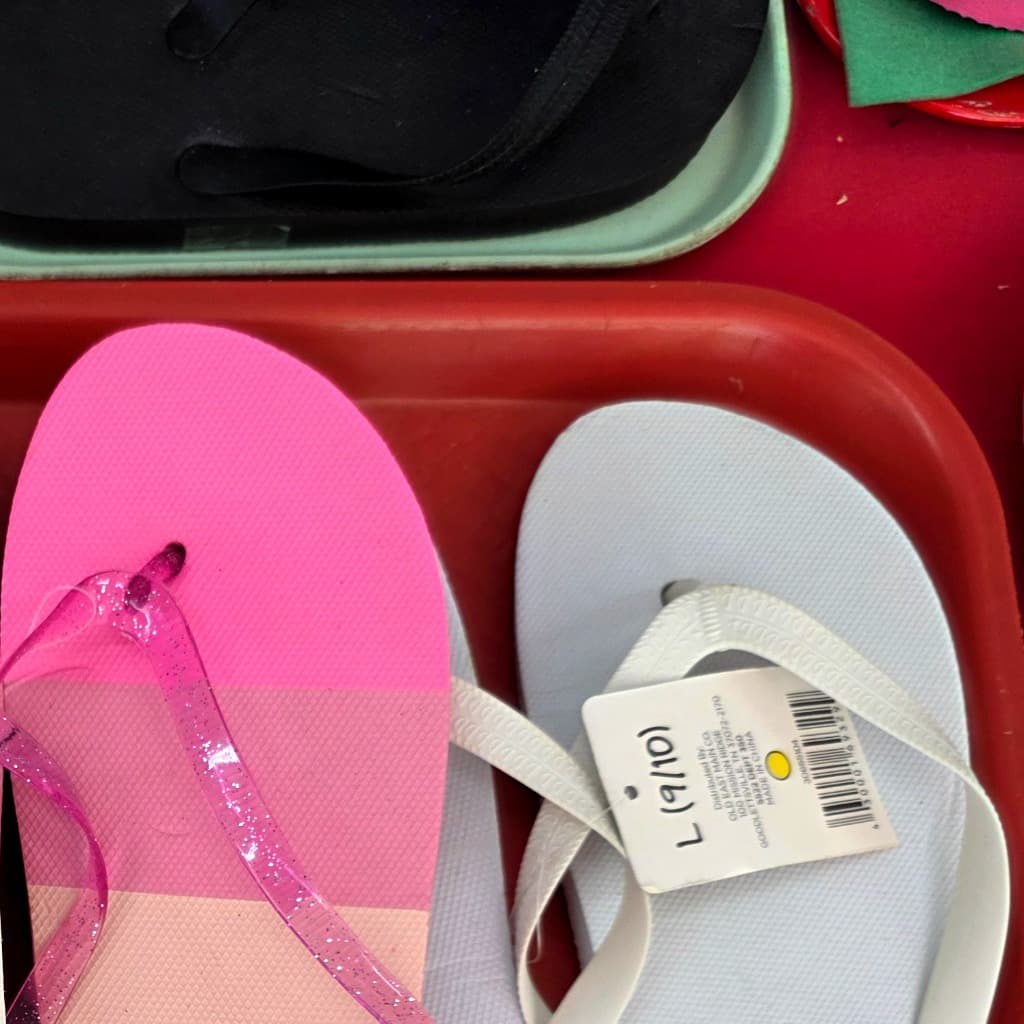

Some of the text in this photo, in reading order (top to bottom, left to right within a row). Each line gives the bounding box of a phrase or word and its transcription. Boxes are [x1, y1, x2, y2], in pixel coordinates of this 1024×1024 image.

[744, 731, 761, 762] CHINA
[707, 748, 722, 773] MAIN
[712, 730, 748, 817] 100 MISSION RIDGE
[742, 756, 756, 781] DEPT
[637, 726, 704, 848] L (9/10)
[716, 775, 731, 799] EAST
[759, 777, 776, 806] MADE
[723, 800, 738, 822] OLD
